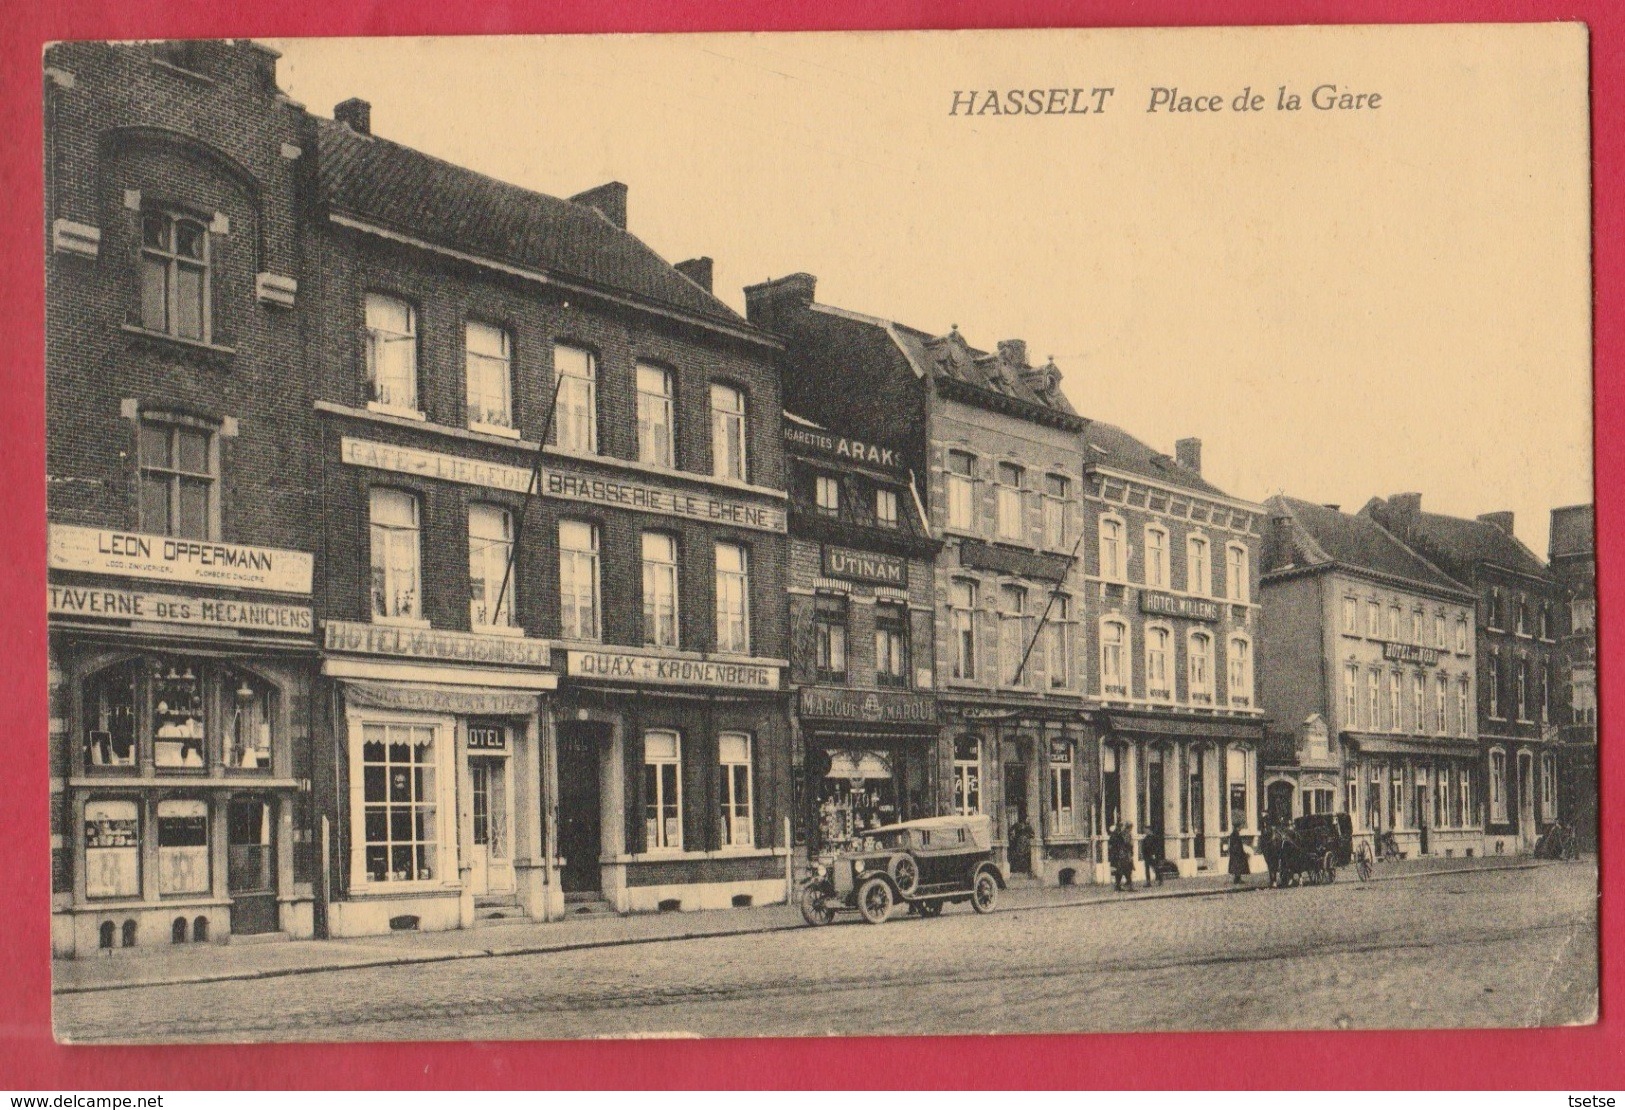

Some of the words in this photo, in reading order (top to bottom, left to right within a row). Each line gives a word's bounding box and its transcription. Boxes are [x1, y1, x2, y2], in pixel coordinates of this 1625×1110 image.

[783, 427, 833, 449] IGARETTES
[549, 473, 662, 509] BRASSERIE
[673, 496, 699, 515] LE
[98, 532, 151, 559] LEON
[163, 540, 273, 572] OPPERMANN
[831, 554, 901, 581] UTINAM
[49, 587, 145, 616] TAVERNE
[156, 600, 191, 620] DES
[202, 602, 311, 630] MECANICIENS
[1147, 594, 1176, 613] HOTEL
[1179, 599, 1218, 619] WILLEMS
[327, 623, 407, 655] HOTEL
[1385, 643, 1410, 660] HOTEL
[656, 660, 770, 686] KRONENBERG
[469, 728, 503, 746] OTEL
